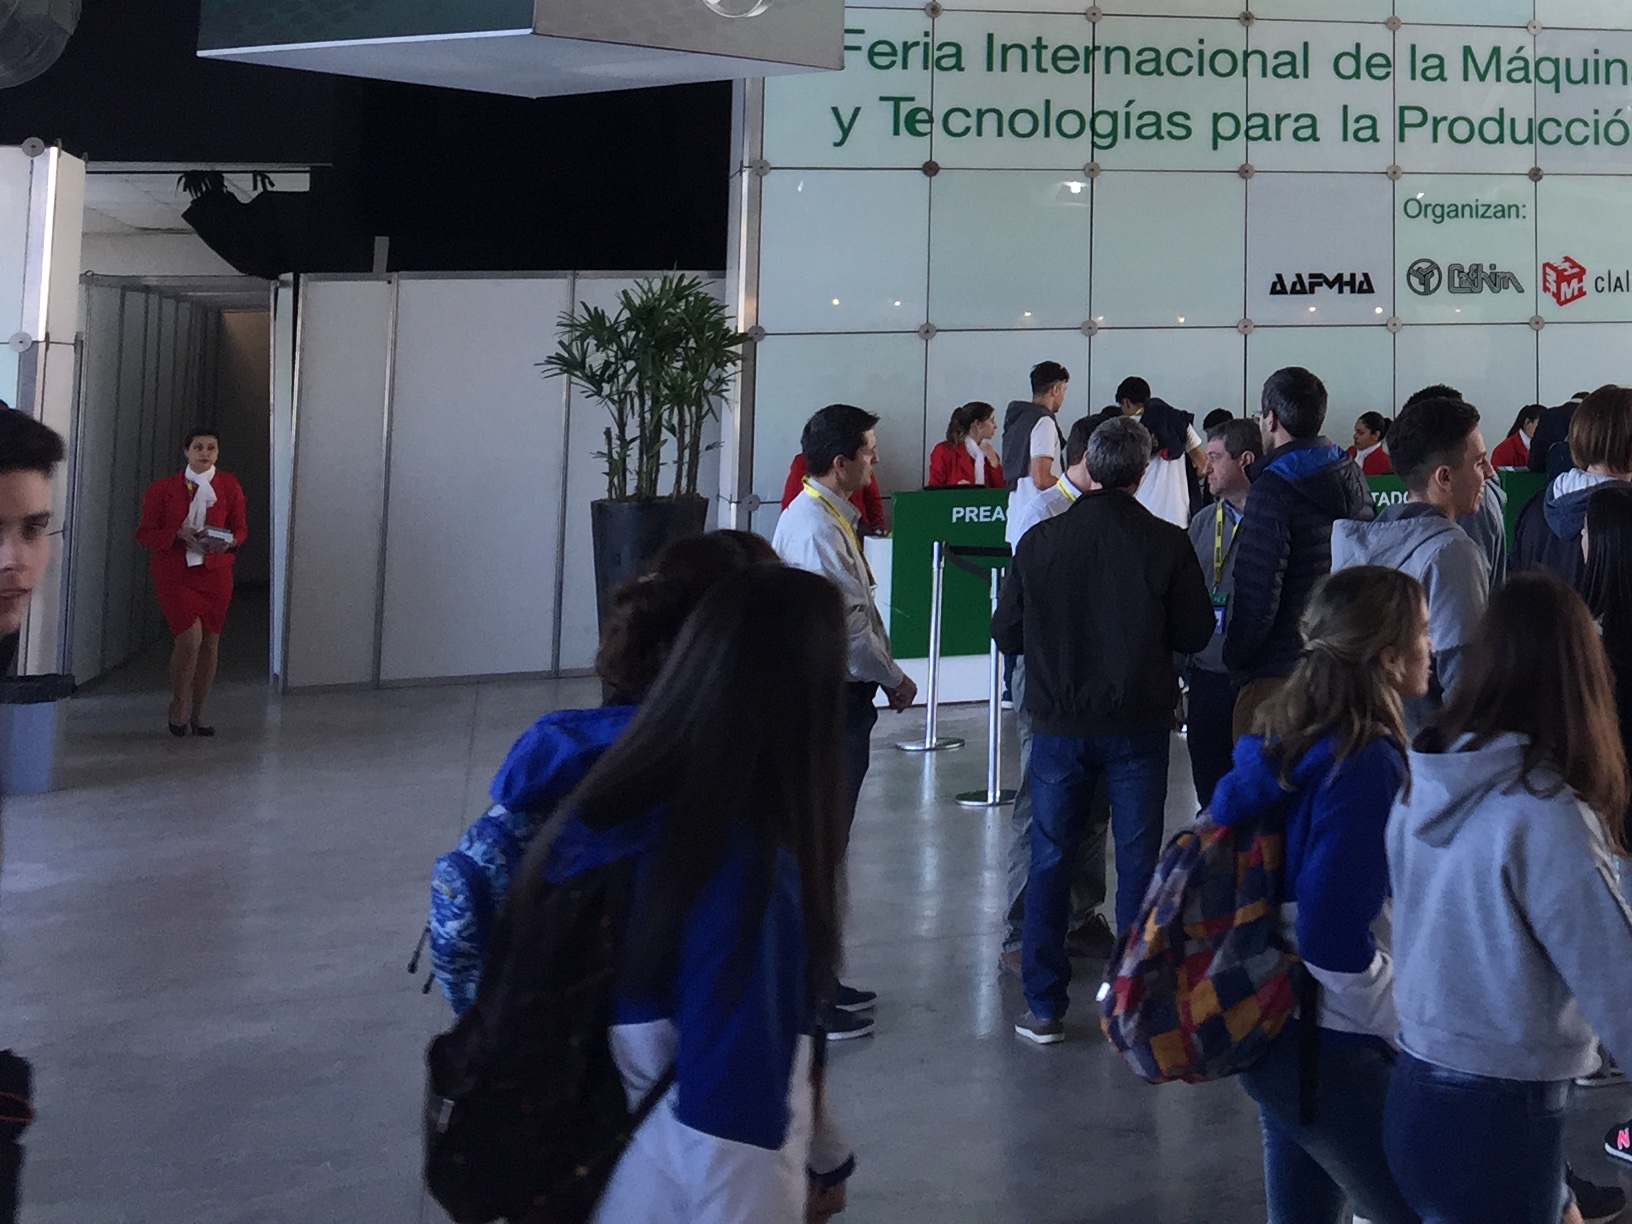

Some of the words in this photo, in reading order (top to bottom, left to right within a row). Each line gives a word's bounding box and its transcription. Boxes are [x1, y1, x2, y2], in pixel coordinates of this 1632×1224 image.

[843, 28, 965, 72] Feria
[985, 32, 1309, 80] Internacional
[1333, 42, 1392, 81] de
[1410, 43, 1447, 82] la
[832, 106, 862, 147] y
[879, 95, 1193, 150] Tecnologías
[1211, 111, 1320, 151] para
[1342, 104, 1380, 143] la
[1403, 197, 1528, 225] Organizan:
